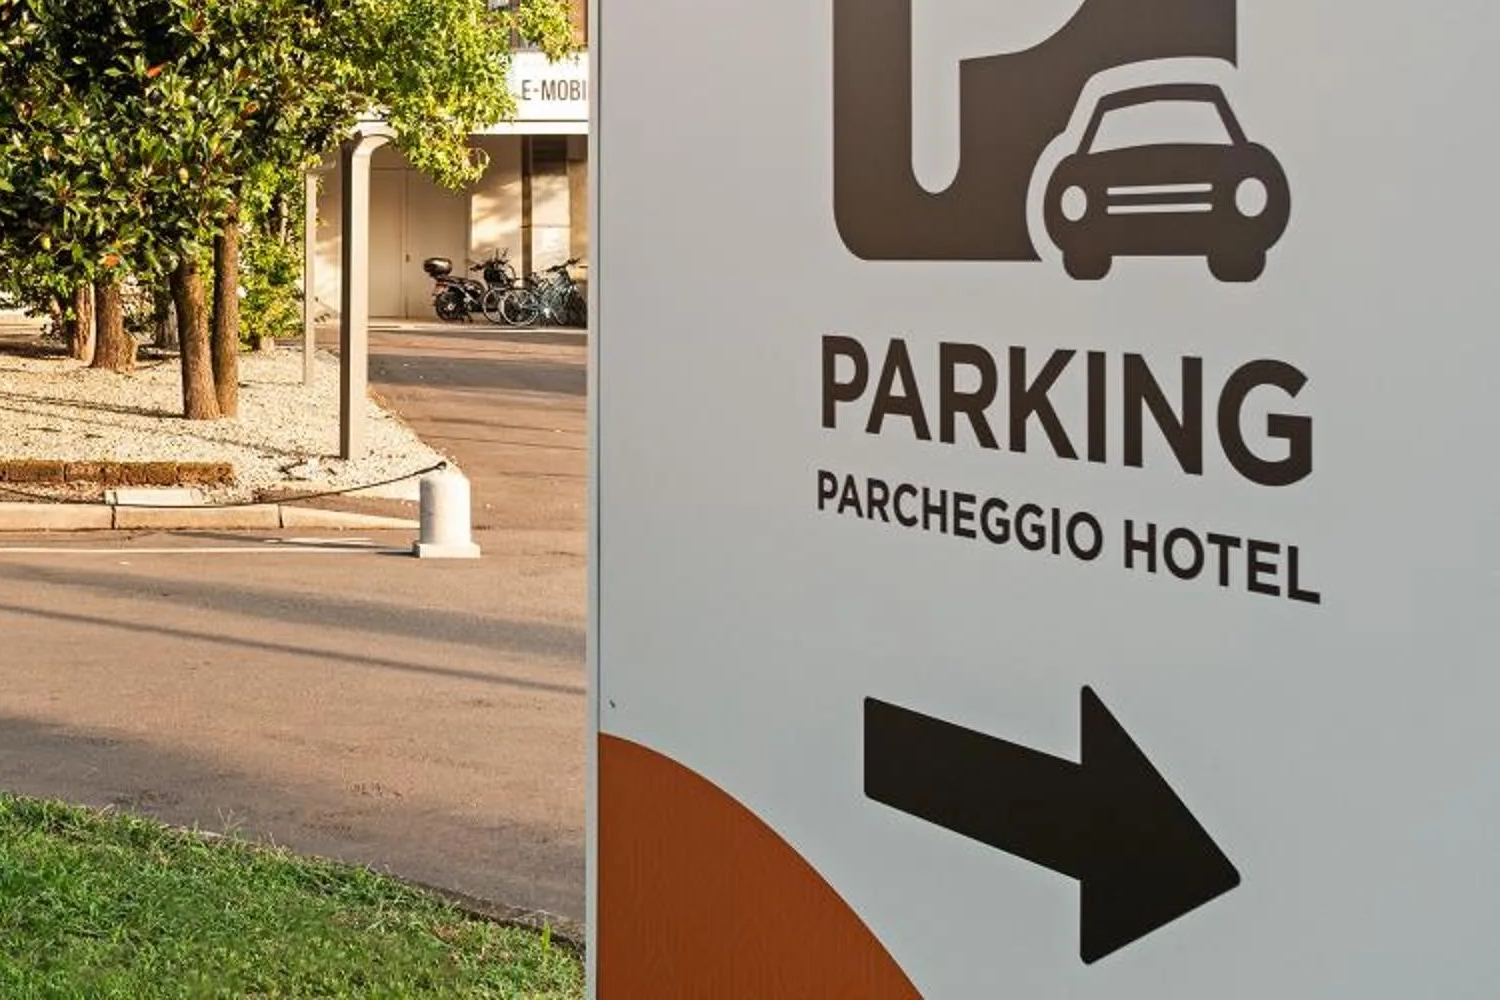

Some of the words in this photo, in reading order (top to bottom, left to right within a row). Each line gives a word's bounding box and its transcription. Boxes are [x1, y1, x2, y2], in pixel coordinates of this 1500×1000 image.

[821, 334, 1313, 487] PARKING
[817, 469, 1103, 561] PARCHEGGIO
[1124, 518, 1321, 604] HOTEL
